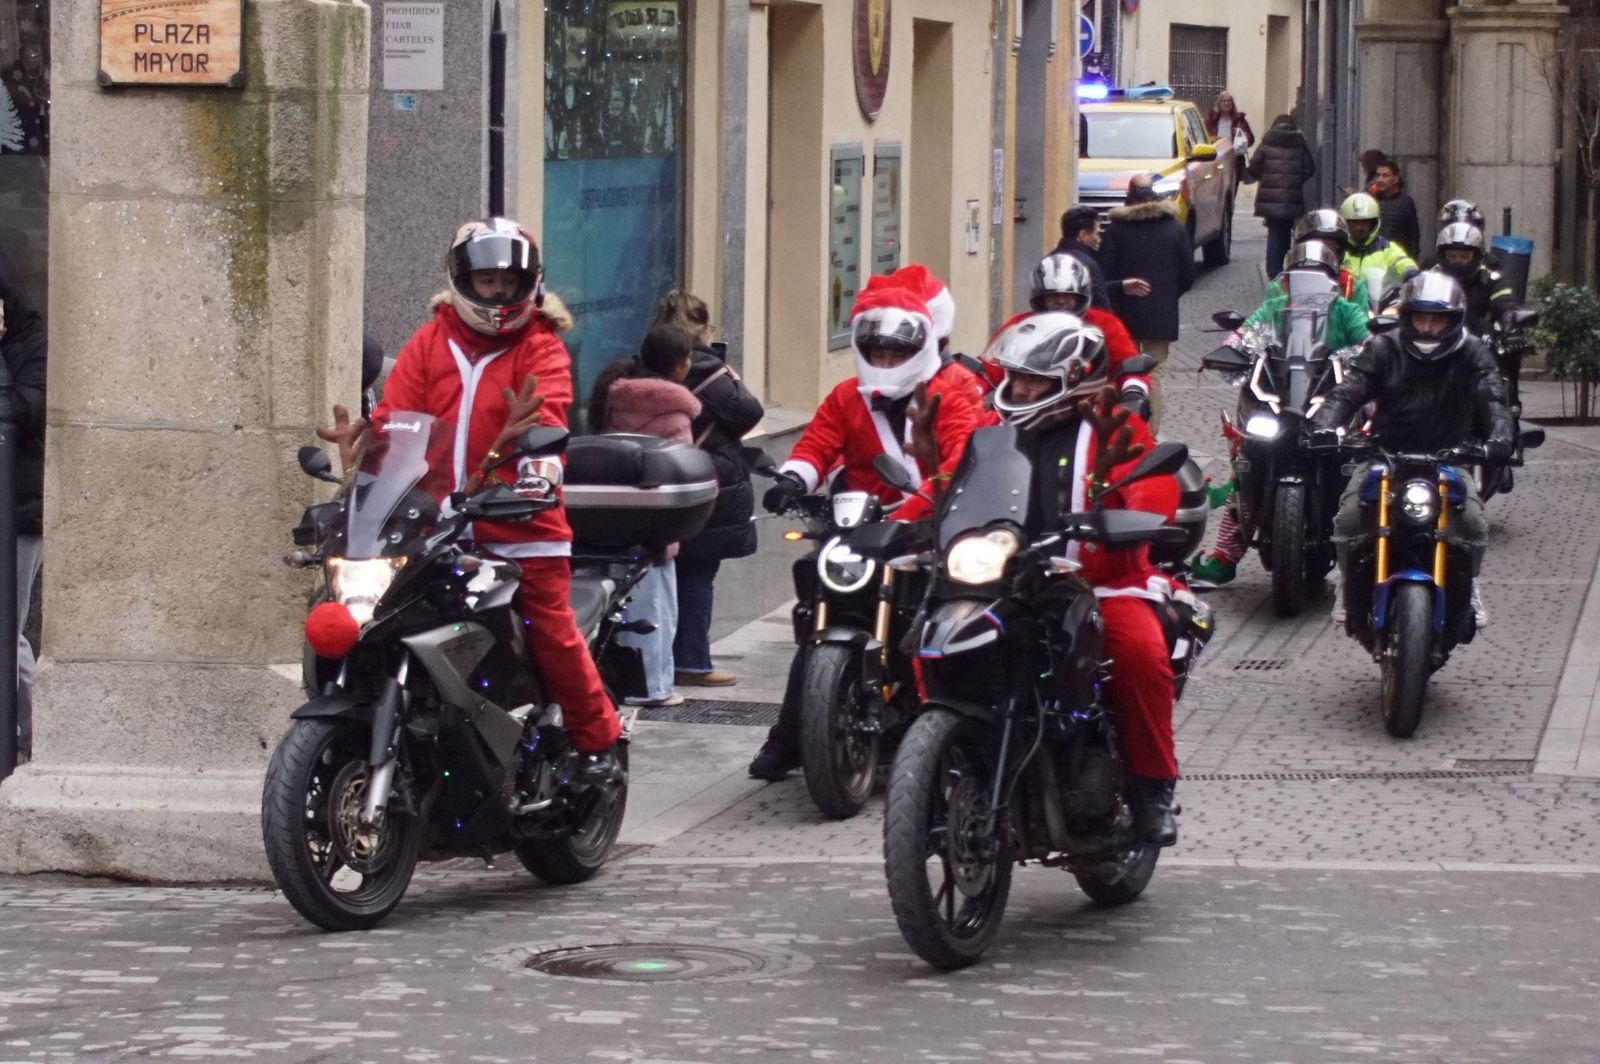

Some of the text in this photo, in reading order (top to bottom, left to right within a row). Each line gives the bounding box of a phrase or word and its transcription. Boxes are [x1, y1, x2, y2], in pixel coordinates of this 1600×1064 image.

[385, 7, 440, 16] PROHIBIDO
[134, 24, 209, 44] PLAZA
[385, 35, 434, 44] CARTELES
[134, 52, 209, 73] MAYOR
